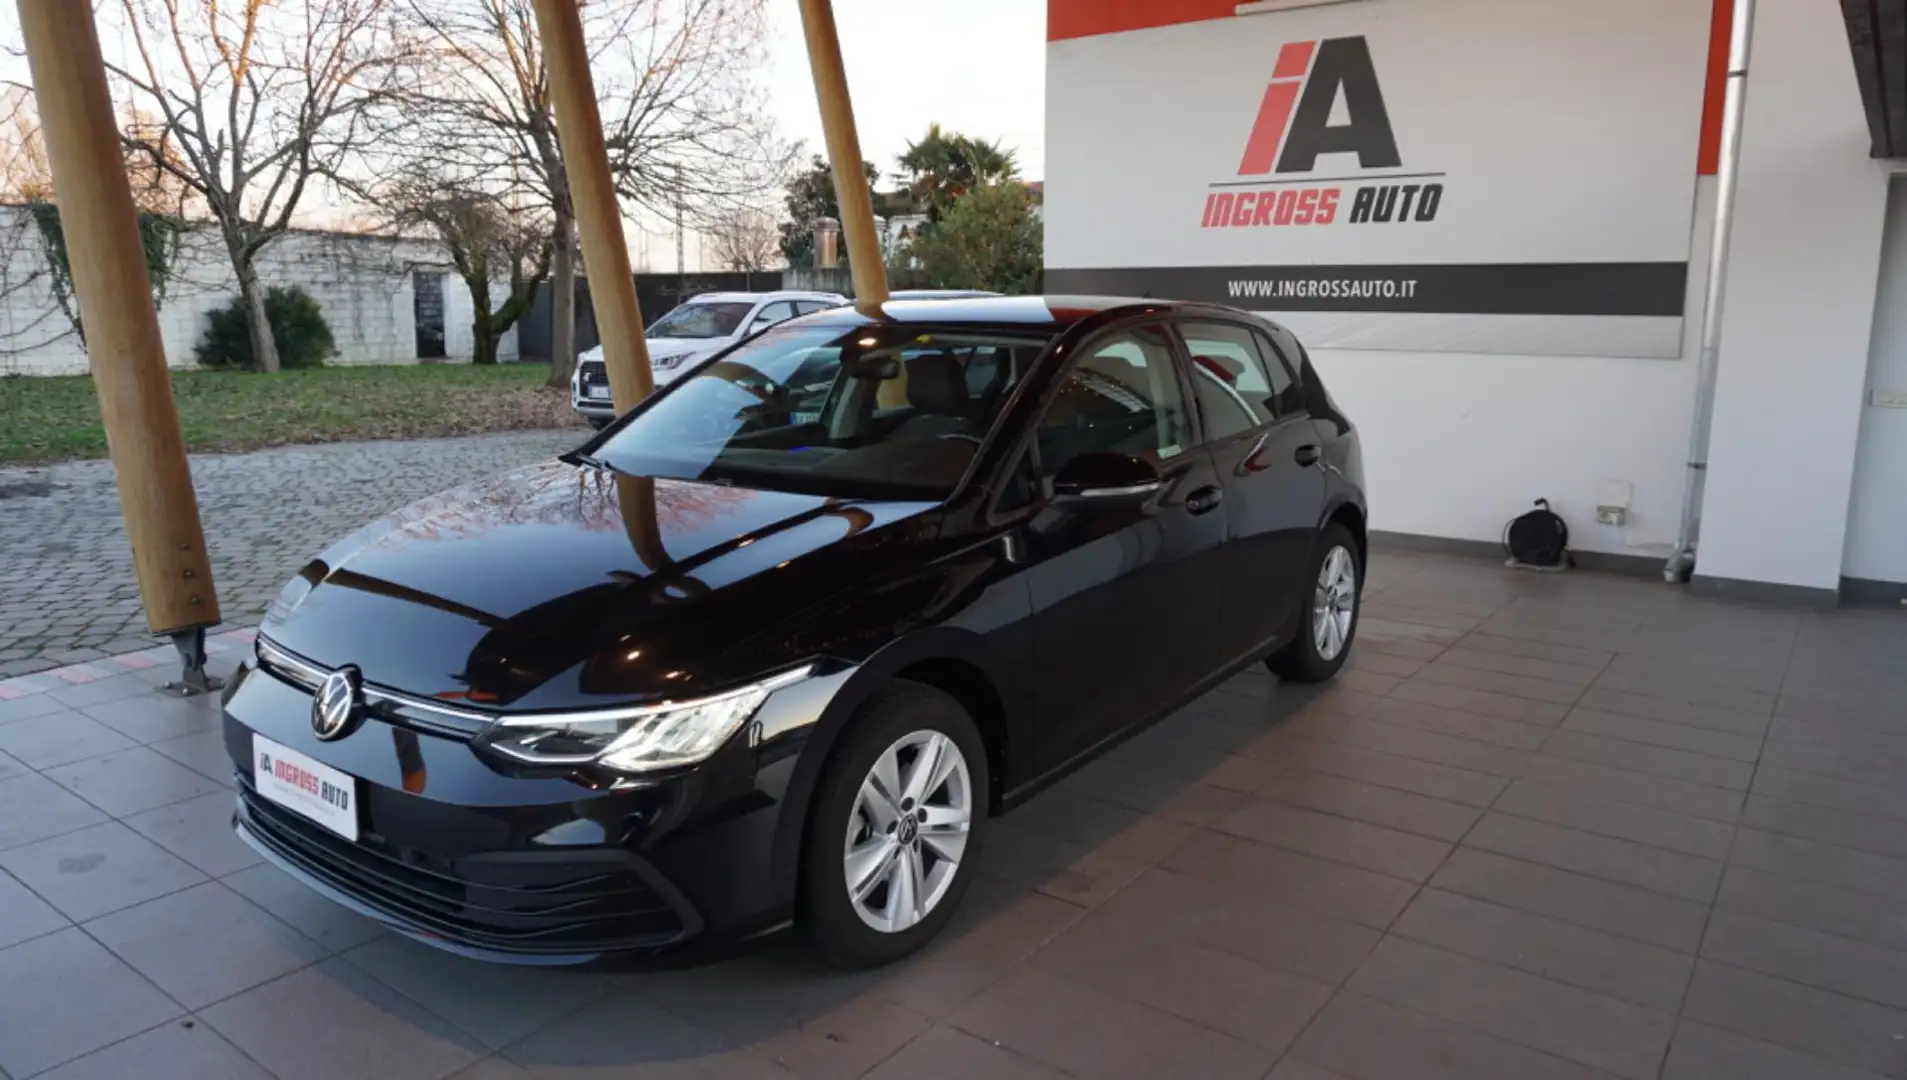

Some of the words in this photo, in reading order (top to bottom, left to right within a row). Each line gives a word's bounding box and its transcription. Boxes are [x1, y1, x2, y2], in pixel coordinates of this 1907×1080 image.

[1200, 188, 1341, 228] INGROSS
[1349, 183, 1443, 224] AUTO
[1228, 280, 1418, 298] WWW.INGROSSAUTO.IT
[275, 759, 319, 796] INGROSS
[321, 780, 349, 811] AUTO
